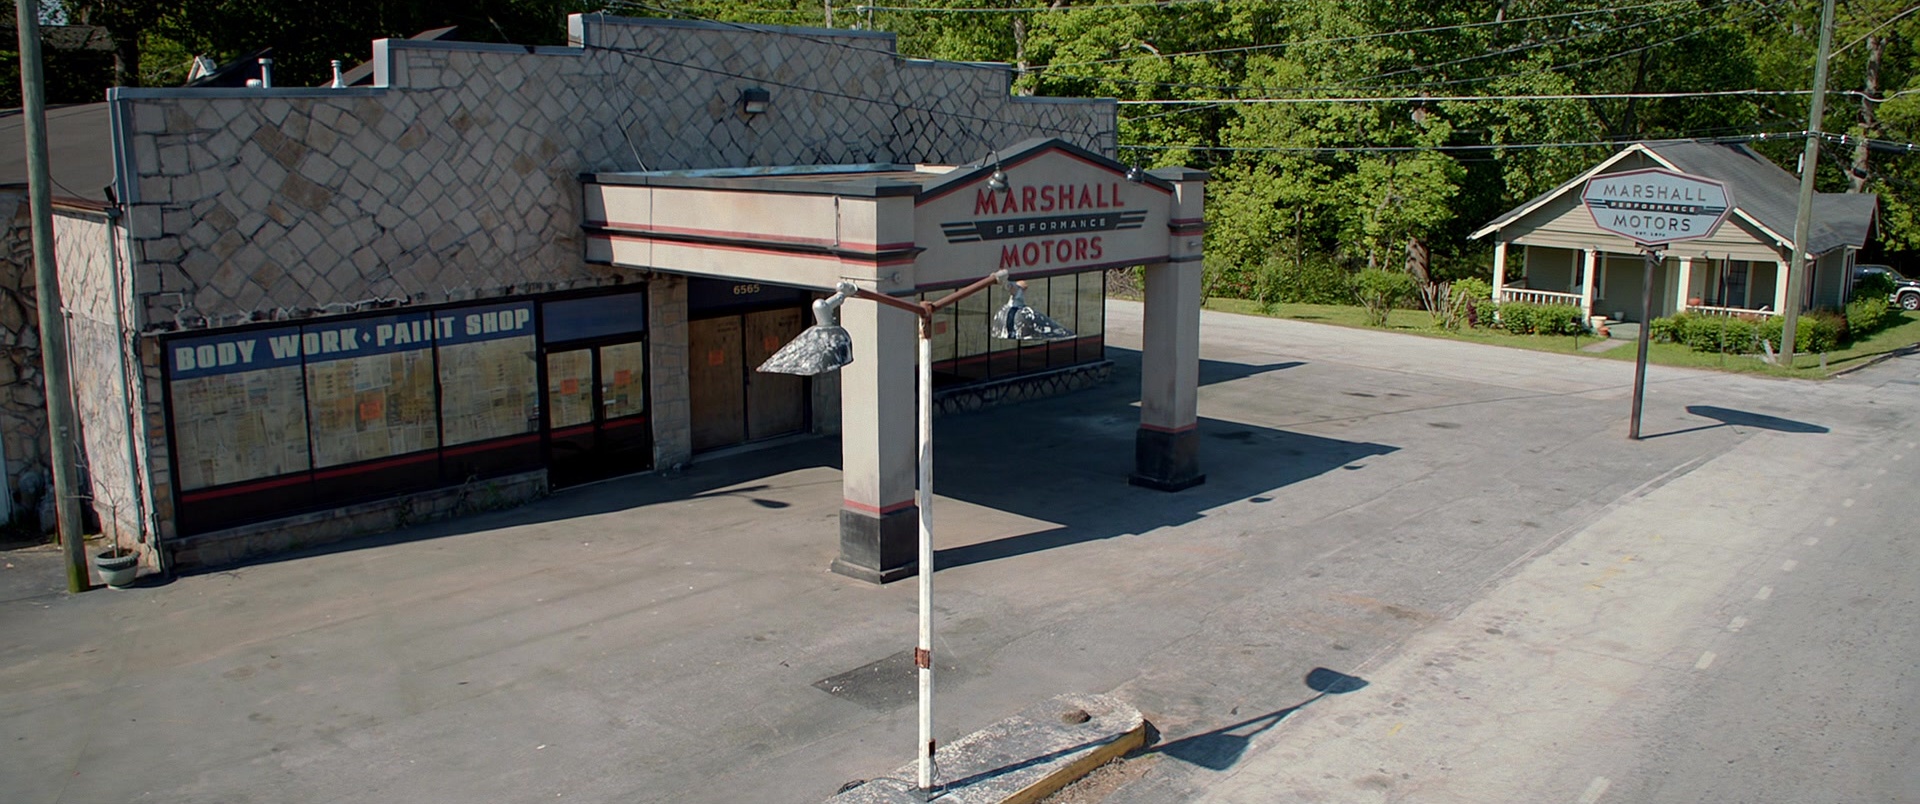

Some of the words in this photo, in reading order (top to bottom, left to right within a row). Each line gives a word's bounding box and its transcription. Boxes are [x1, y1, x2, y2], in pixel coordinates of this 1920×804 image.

[974, 183, 1124, 215] MARSHALL
[1603, 184, 1706, 201] MARSHALL
[1611, 202, 1695, 213] PERFORMANCE
[996, 218, 1106, 234] PERFORMANCE
[1613, 215, 1691, 231] MOTORS
[1000, 237, 1103, 269] MOTORS
[733, 284, 760, 295] 6565
[175, 340, 255, 371] BODY
[269, 328, 359, 359] WORK
[376, 317, 454, 347] PAINT
[466, 308, 529, 336] SHOP
